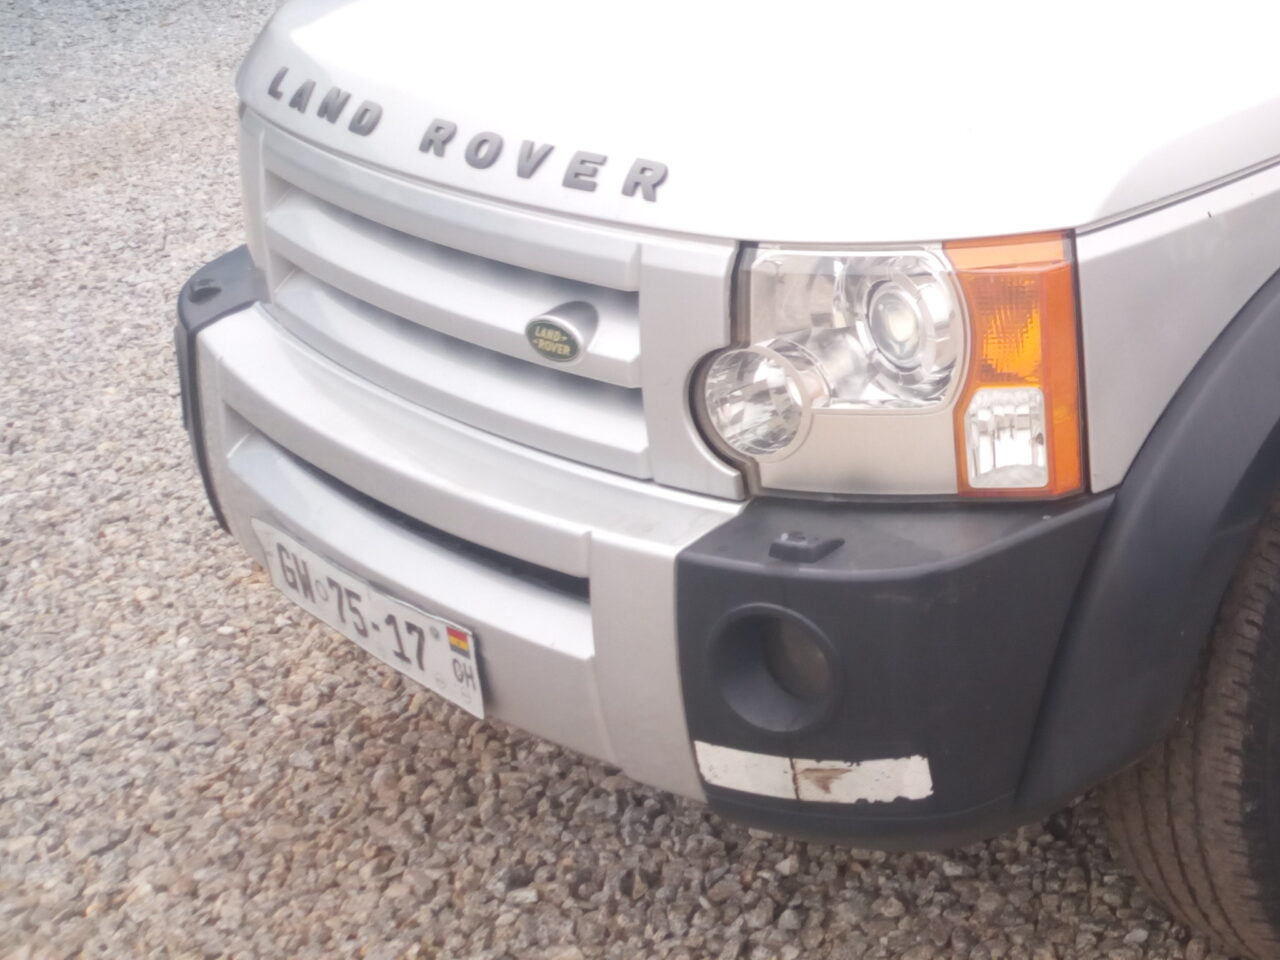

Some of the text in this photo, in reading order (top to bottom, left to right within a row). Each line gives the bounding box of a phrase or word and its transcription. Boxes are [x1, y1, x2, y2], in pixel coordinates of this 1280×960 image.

[268, 66, 669, 202] LAND ROVER
[326, 576, 425, 672] 75-17
